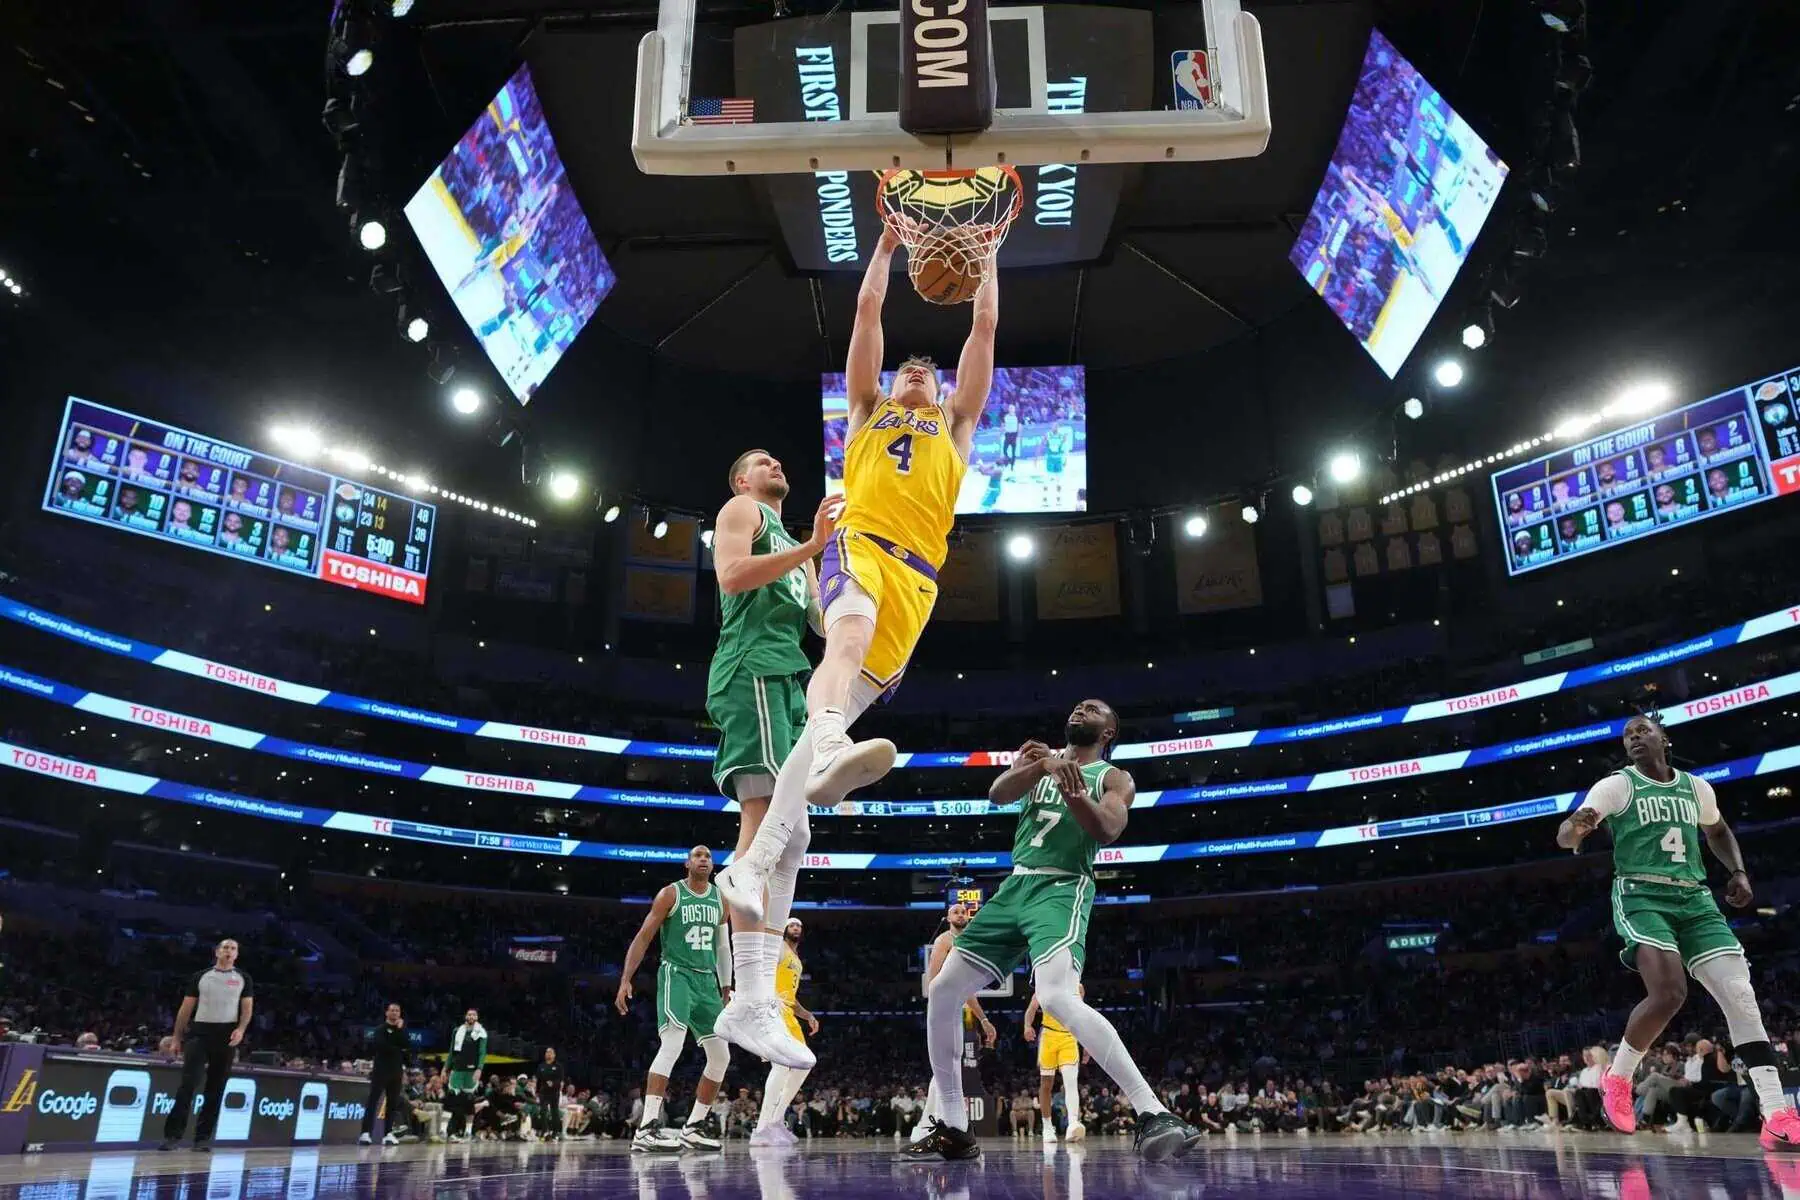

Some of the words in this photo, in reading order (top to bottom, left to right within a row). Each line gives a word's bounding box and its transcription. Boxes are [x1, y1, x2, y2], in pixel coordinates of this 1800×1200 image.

[795, 46, 841, 120] FIRST
[1035, 177, 1076, 226] YOU
[815, 171, 858, 262] PONDERS
[871, 411, 939, 435] LAKERS
[1728, 420, 1737, 436] 2
[163, 431, 186, 449] ON
[185, 437, 209, 457] THE
[209, 445, 252, 470] COURT
[886, 433, 913, 474] 4
[1573, 447, 1591, 466] ON
[1591, 439, 1615, 458] THE
[1615, 423, 1656, 452] COURT
[1685, 478, 1695, 495] 3
[304, 496, 316, 510] 2
[363, 492, 376, 507] 34
[377, 496, 387, 511] 14
[417, 508, 429, 523] 48
[1632, 494, 1646, 511] 15
[201, 508, 216, 524] 15
[361, 511, 373, 526] 23
[374, 515, 384, 530] 13
[252, 522, 263, 536] 3
[366, 534, 395, 557] 5:00
[327, 558, 420, 596] TOSHIBA
[204, 663, 279, 693] TOSHIBA
[1149, 738, 1214, 755] TOSHIBA
[1447, 687, 1520, 712] TOSHIBA
[1350, 761, 1422, 783] TOSHIBA
[1685, 684, 1771, 718] TOSHIBA
[129, 705, 213, 736] TOSHIBA
[464, 774, 536, 793] TOSHIBA
[520, 728, 587, 747] TOSHIBA
[12, 750, 98, 782] TOSHIBA
[868, 802, 885, 813] 48
[941, 802, 972, 815] 5:00
[1635, 795, 1698, 829] BOSTON
[1030, 809, 1062, 848] 7
[1660, 826, 1687, 863] 4
[957, 889, 981, 901] 5:00
[681, 904, 719, 926] BOSTON
[685, 926, 714, 951] 42
[38, 1089, 98, 1120] Google
[151, 1093, 177, 1115] Pix
[258, 1096, 295, 1121] Google
[328, 1102, 348, 1120] Pixel
